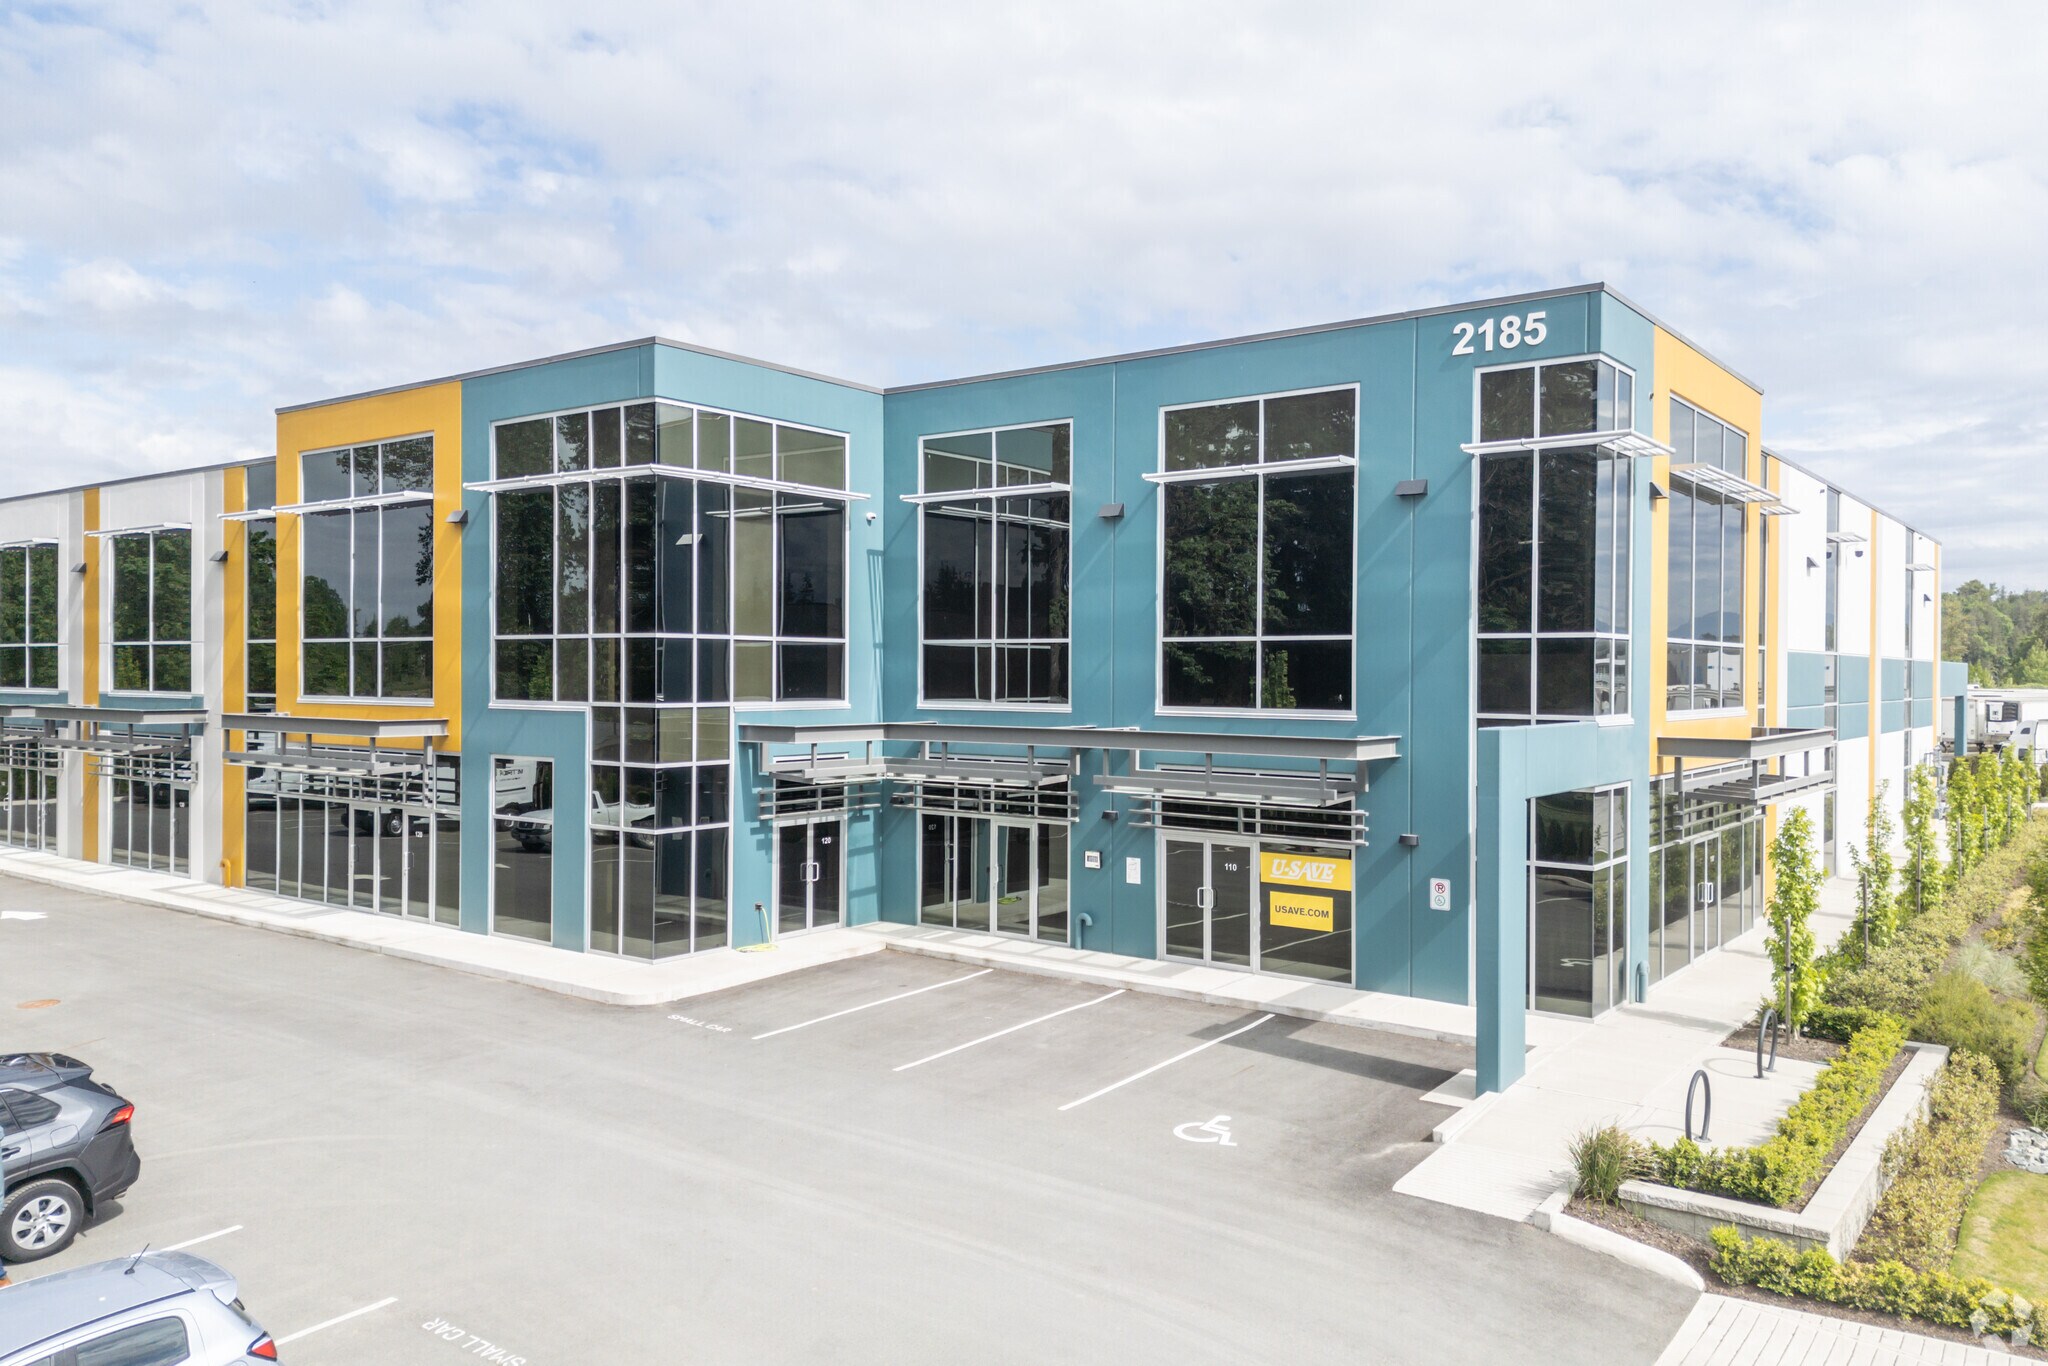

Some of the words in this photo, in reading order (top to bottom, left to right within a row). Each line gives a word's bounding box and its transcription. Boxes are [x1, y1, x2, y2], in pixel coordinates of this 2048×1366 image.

[1452, 311, 1547, 356] 2185
[1224, 863, 1238, 872] 110
[1269, 858, 1336, 883] U-SAVE
[1274, 905, 1330, 918] USAVE.COM
[421, 1317, 466, 1341] CAR
[461, 1334, 527, 1366] SMALL
